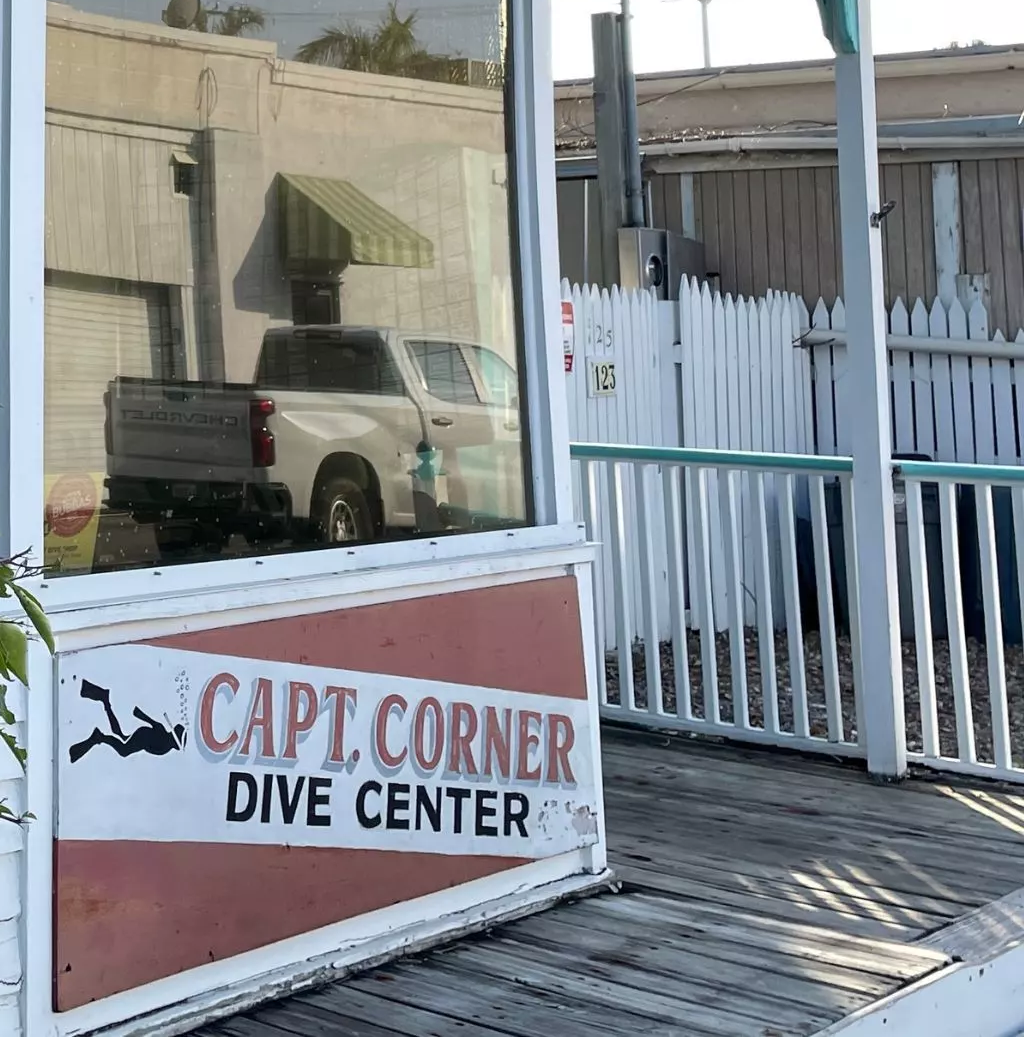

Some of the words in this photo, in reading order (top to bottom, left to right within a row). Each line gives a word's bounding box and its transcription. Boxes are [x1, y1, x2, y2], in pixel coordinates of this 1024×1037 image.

[595, 365, 616, 390] 123
[198, 671, 362, 766] CAPT.
[376, 693, 578, 785] CORNER
[225, 772, 332, 826] DIVE
[355, 780, 530, 838] CENTER
